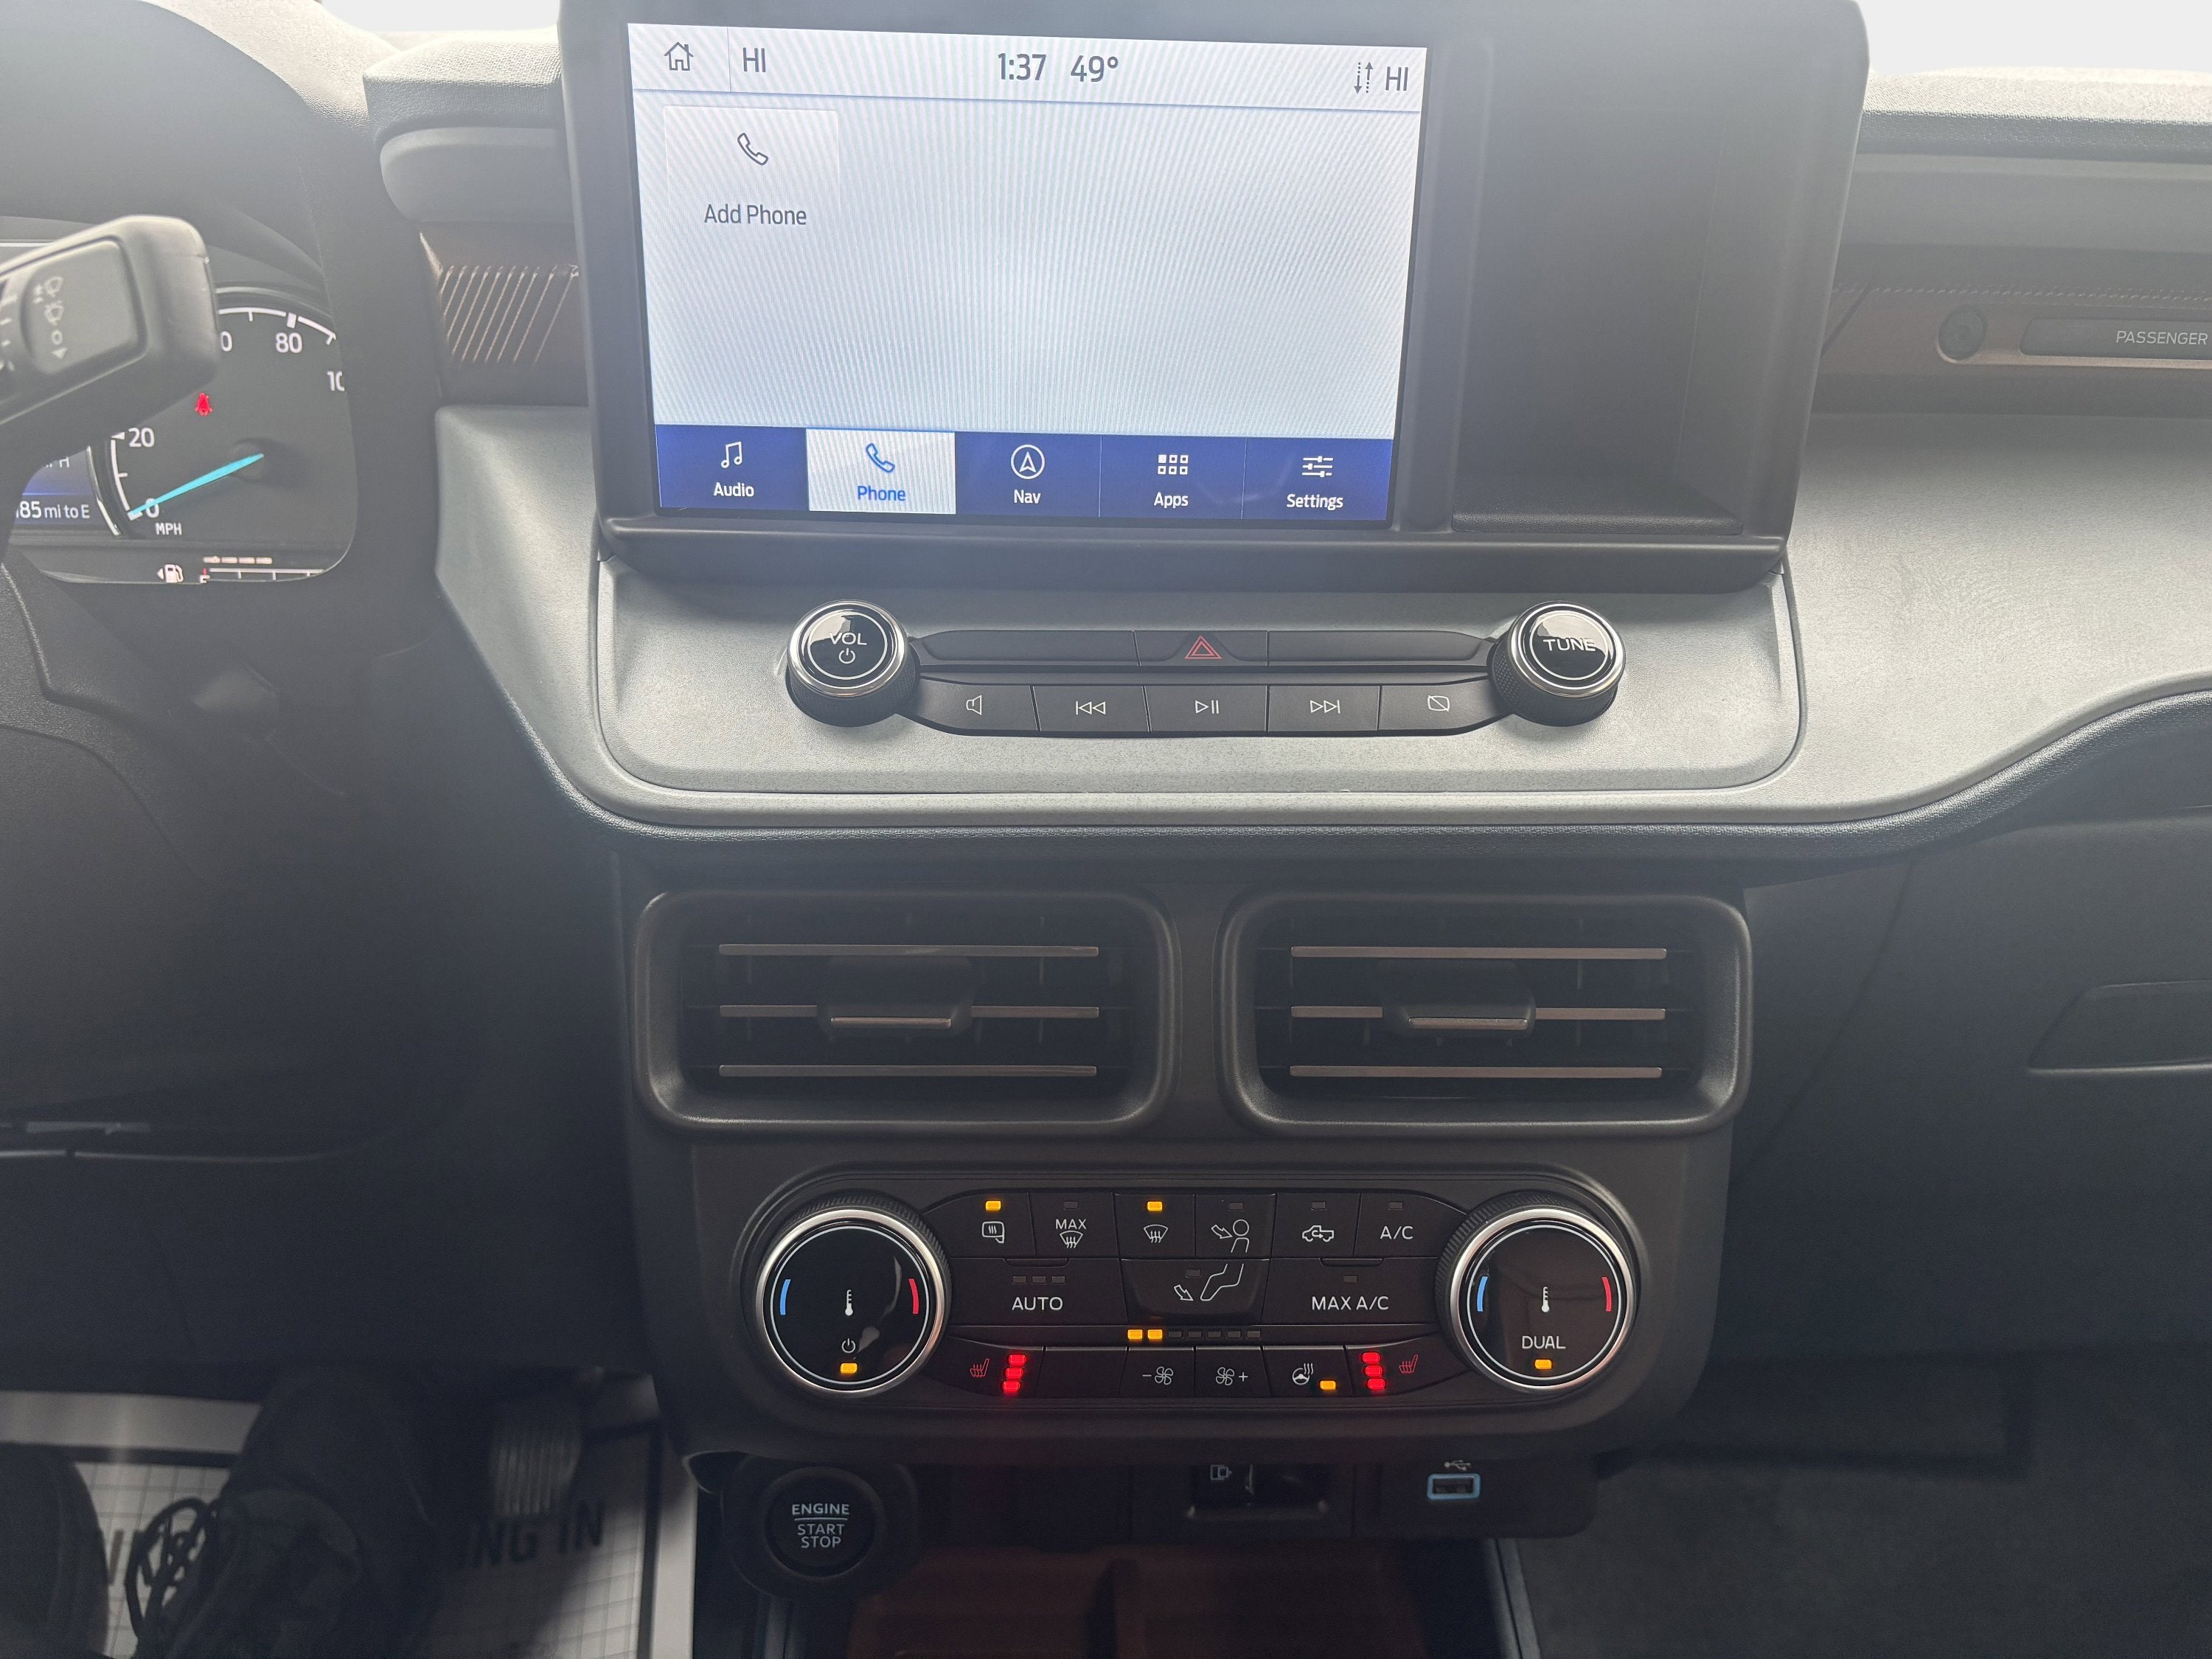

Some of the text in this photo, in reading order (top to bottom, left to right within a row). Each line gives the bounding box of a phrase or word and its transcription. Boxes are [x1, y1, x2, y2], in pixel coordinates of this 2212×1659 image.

[742, 47, 767, 73] HI
[998, 52, 1046, 82] 1:37
[1070, 54, 1119, 83] 49°
[1385, 66, 1408, 91] HI
[703, 203, 807, 226] Add Phone
[276, 332, 302, 353] 80
[2116, 330, 2208, 346] PASSENGER
[128, 427, 155, 448] 20
[713, 481, 754, 497] Audio
[857, 484, 906, 502] Phone
[1014, 488, 1041, 504] Nav
[145, 498, 159, 518] 0
[1153, 492, 1189, 509] Apps
[1286, 493, 1343, 512] Settings
[44, 504, 60, 518] mi
[63, 504, 78, 518] to
[81, 504, 90, 518] E
[155, 522, 182, 536] MPH
[830, 632, 868, 646] VOL
[1543, 636, 1596, 653] TUNE
[1055, 1218, 1088, 1231] MAX
[1380, 1225, 1413, 1239] A/C
[1012, 1296, 1064, 1312] AUTO
[1312, 1296, 1390, 1311] MAX A/C
[1522, 1335, 1566, 1349] DUAL
[792, 1503, 850, 1515] ENGINE
[797, 1523, 845, 1536] START
[801, 1536, 841, 1548] STOP
